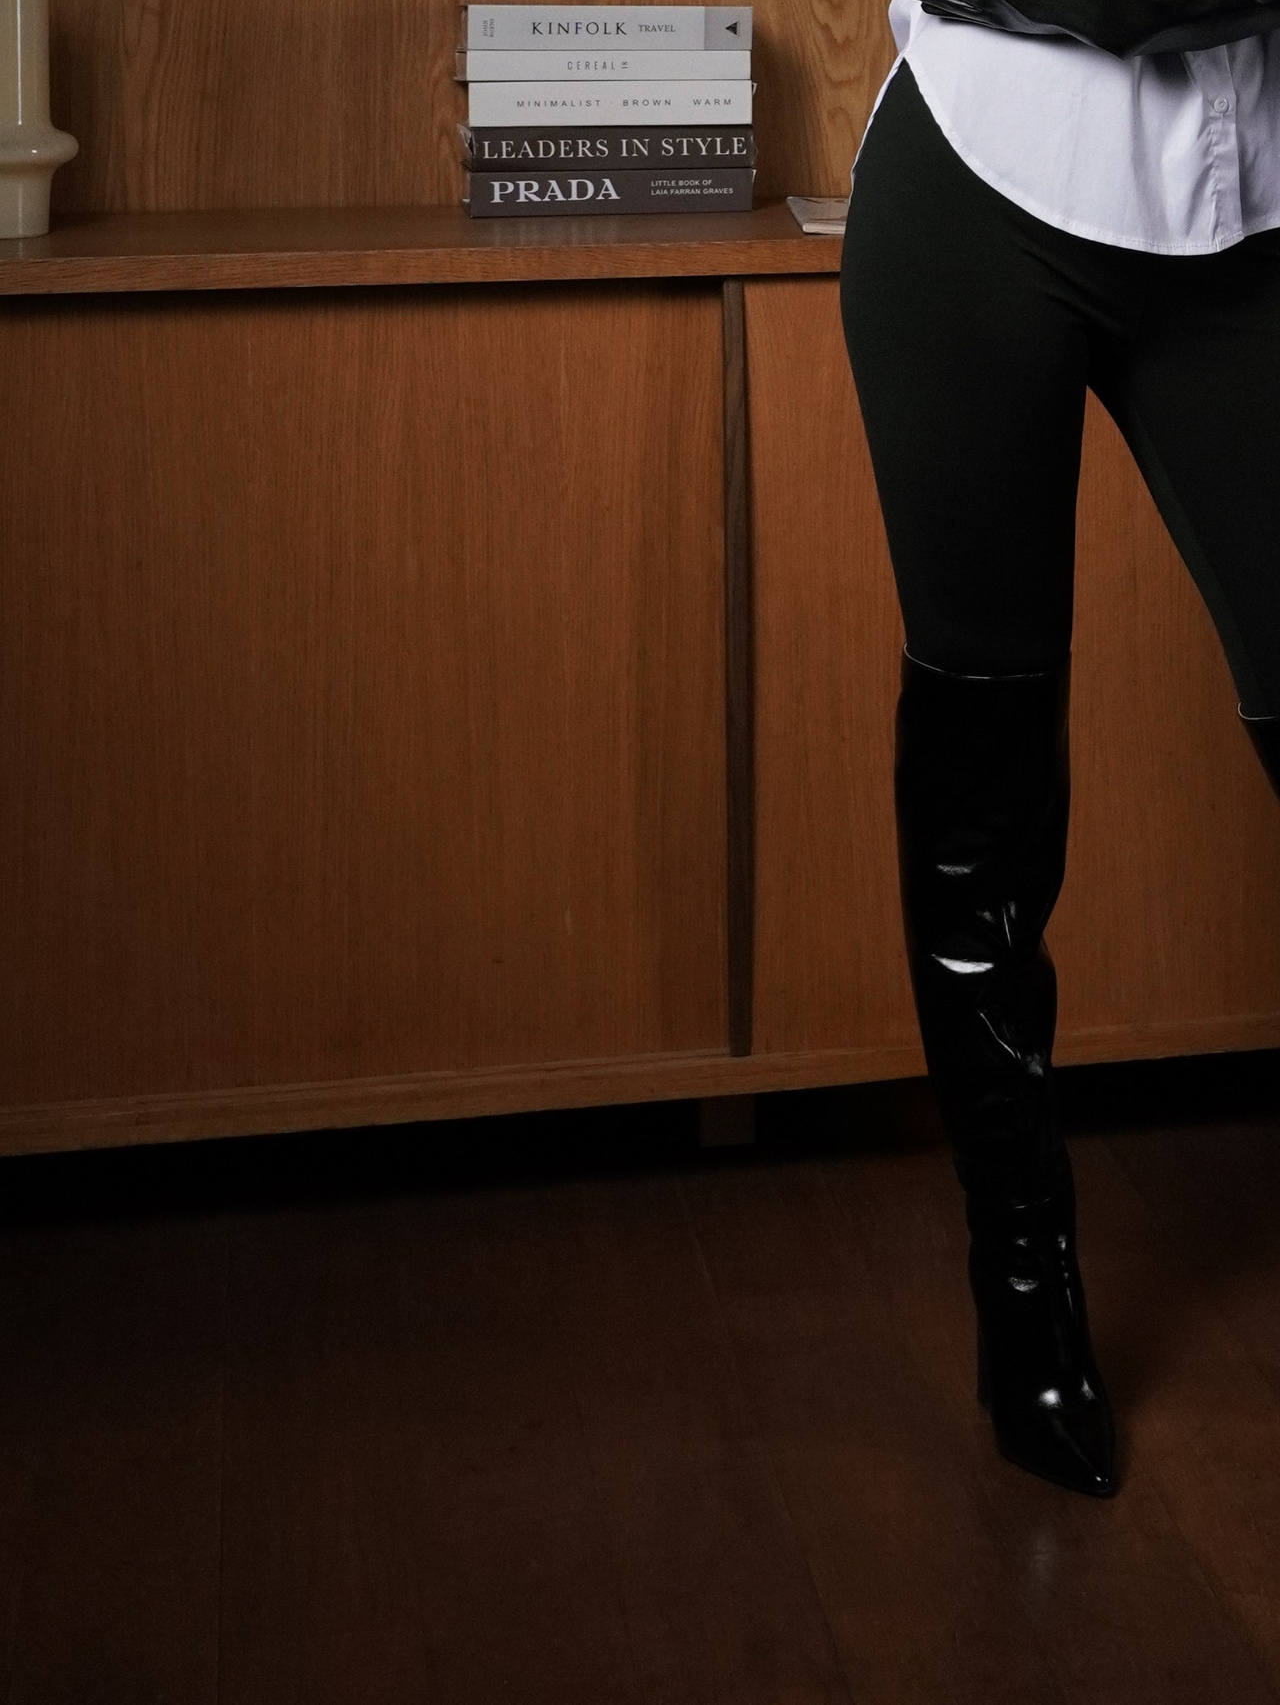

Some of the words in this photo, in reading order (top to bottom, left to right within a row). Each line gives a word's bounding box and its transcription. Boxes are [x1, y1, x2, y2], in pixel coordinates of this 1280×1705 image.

[532, 21, 627, 35] KINFOLK
[638, 24, 676, 33] TRAVEL
[567, 60, 615, 71] CEREAL
[516, 99, 601, 108] MINIMALIST
[622, 99, 671, 107] BROWN
[692, 98, 732, 106] WARM
[483, 139, 609, 159] LEADERS
[621, 138, 650, 157] IN
[661, 137, 747, 156] STYLE
[651, 179, 676, 187] LITTLE
[678, 179, 700, 187] BOOK
[701, 179, 713, 187] OF
[491, 179, 620, 202] PRADA
[702, 187, 734, 195] GRAVES
